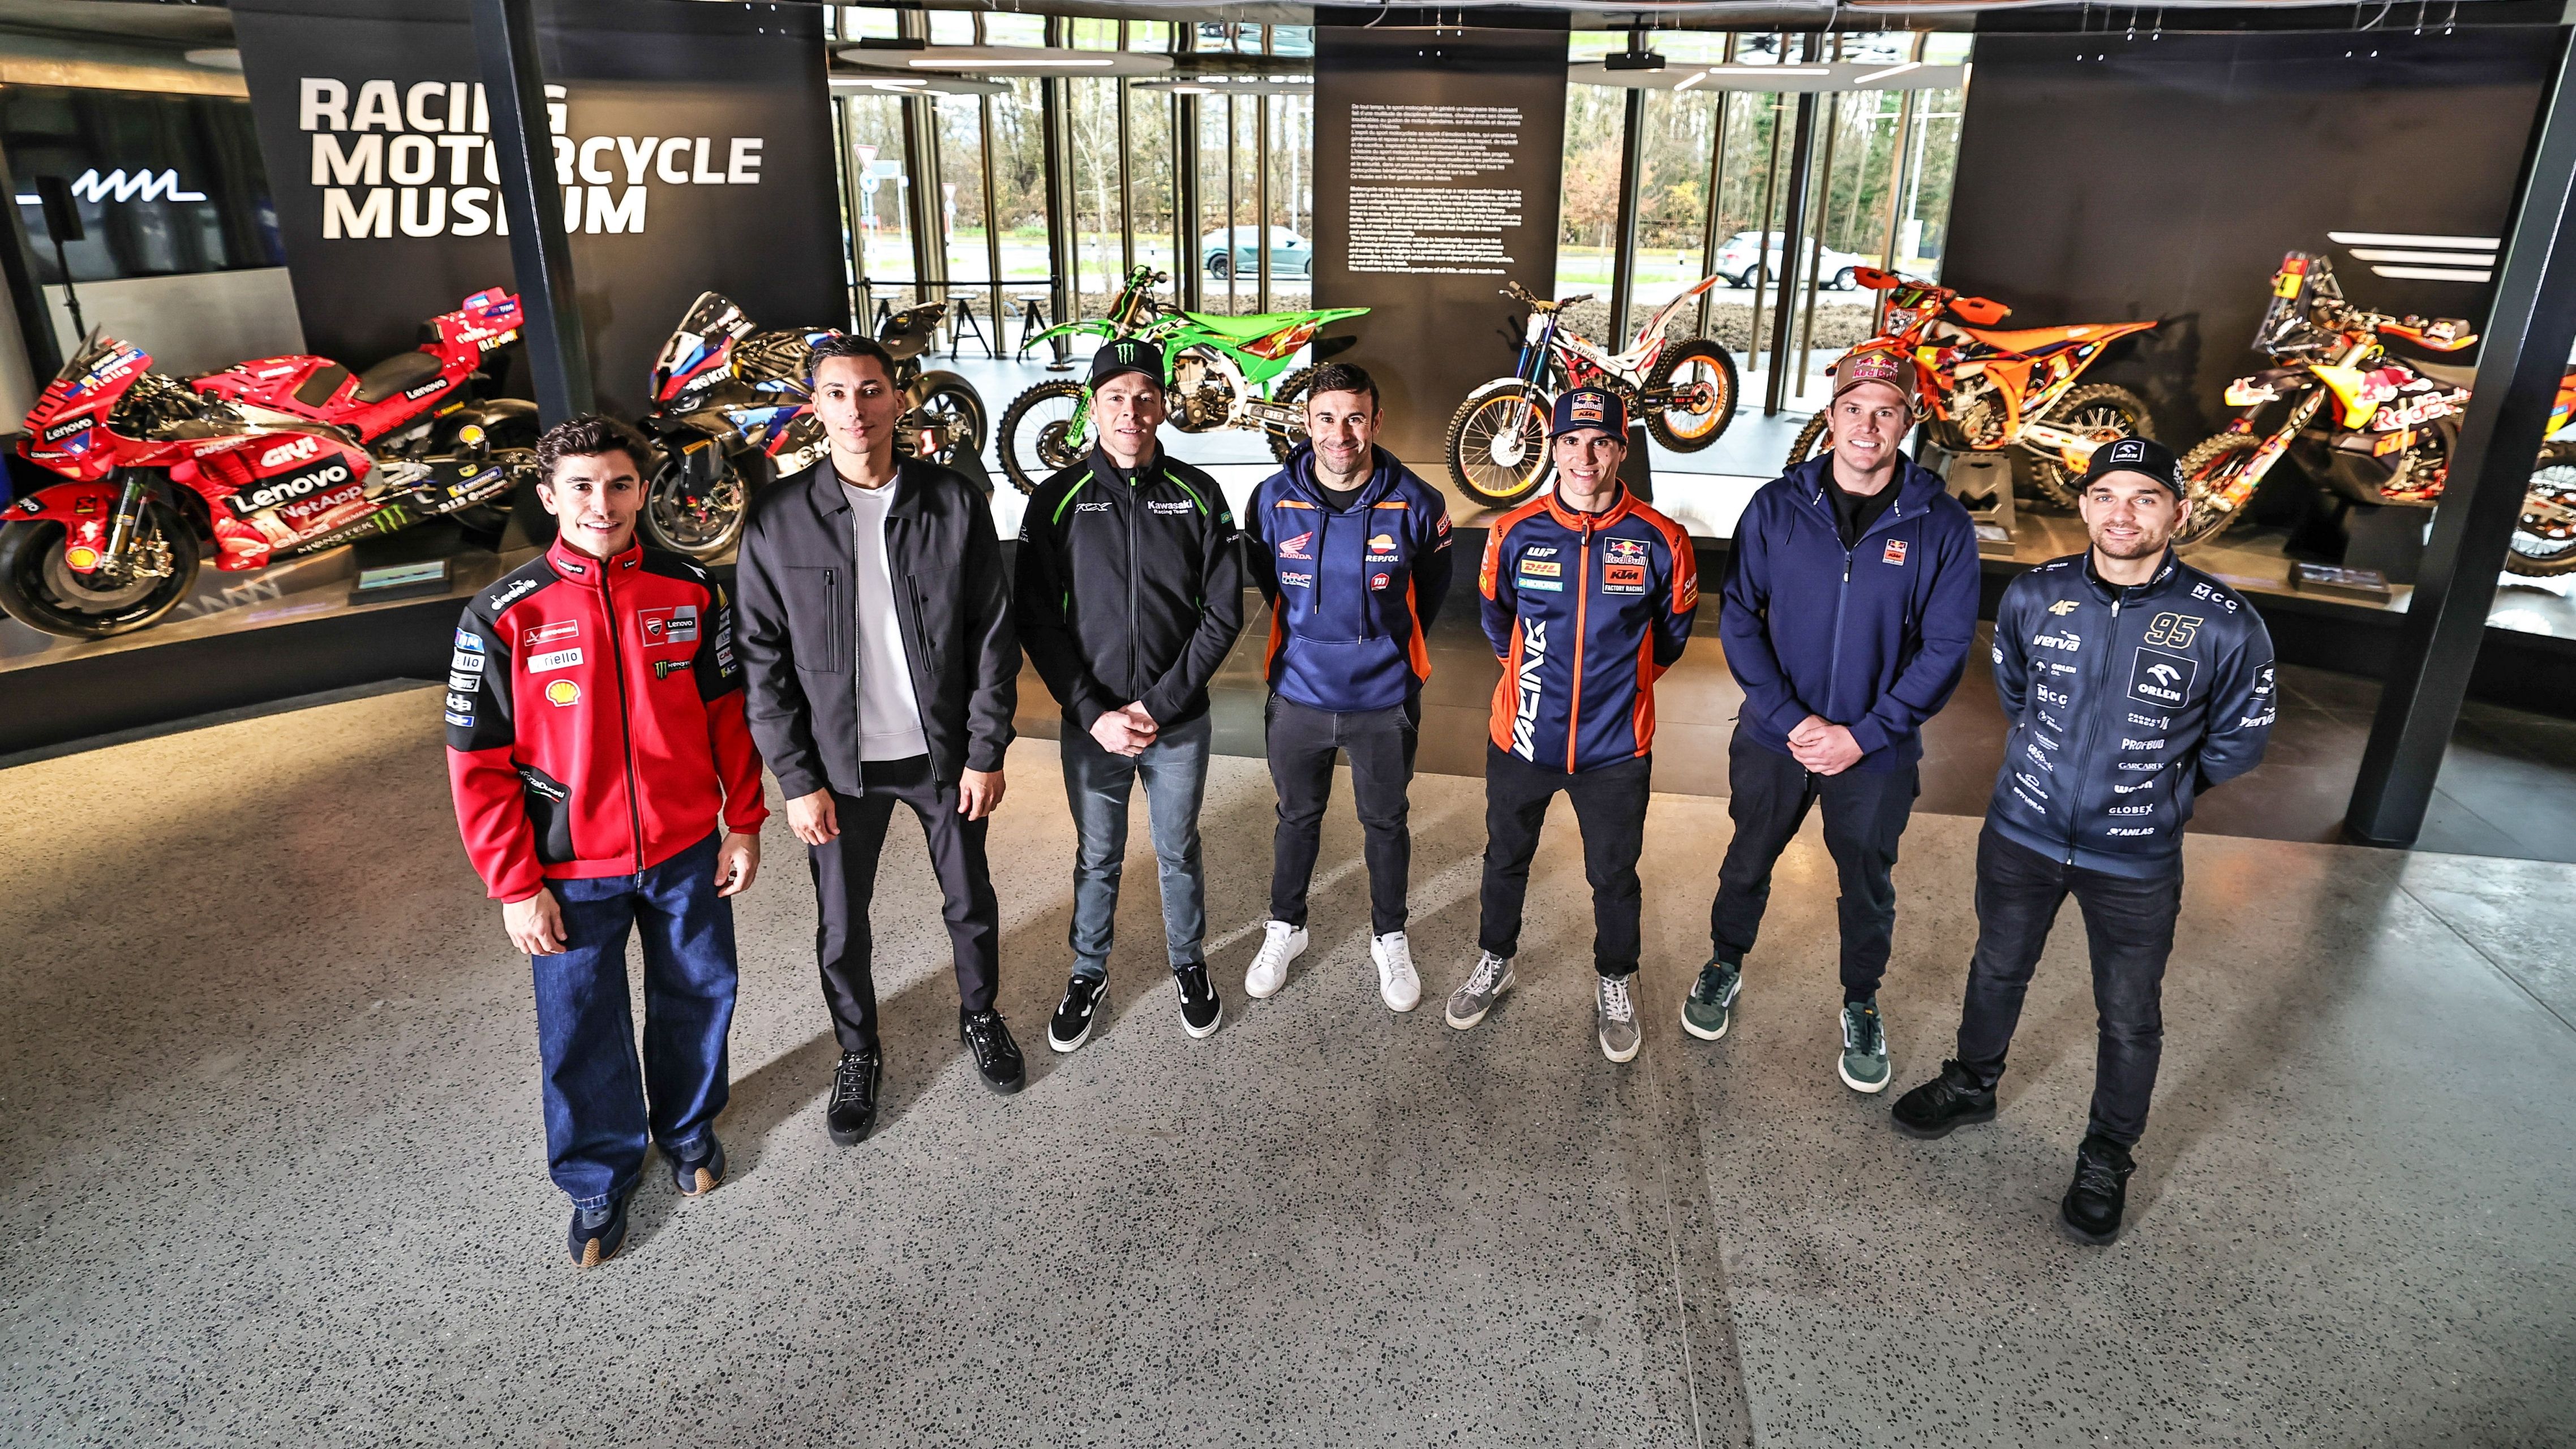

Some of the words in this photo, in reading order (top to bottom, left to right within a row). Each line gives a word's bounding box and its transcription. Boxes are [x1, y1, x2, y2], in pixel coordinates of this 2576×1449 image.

[299, 77, 568, 134] RACIG
[312, 133, 764, 186] MOTRCYCLE
[323, 185, 647, 240] MUSM
[1571, 343, 1599, 360] REPSOL
[1853, 368, 1875, 380] Red
[1875, 369, 1897, 382] Bull
[406, 379, 448, 399] Lenovo
[1573, 401, 1589, 410] Red
[1588, 403, 1603, 411] Bull
[45, 418, 93, 440] Lenovo
[920, 429, 938, 455] 1
[233, 466, 348, 513] Lenovo
[281, 485, 364, 517] NetApp
[1148, 499, 1193, 509] Kawasaki
[1526, 547, 1558, 557] WP
[1605, 552, 1626, 564] Red
[1625, 554, 1647, 566] Bull
[1524, 562, 1557, 574] DHL
[1609, 569, 1639, 581] KTM
[1282, 571, 1312, 583] HRC
[491, 579, 538, 610] diadora
[2048, 600, 2080, 616] 4F
[667, 620, 693, 629] Lenovo
[2143, 612, 2205, 650] 95
[2033, 634, 2081, 652] verva
[544, 652, 578, 666] riello
[2051, 663, 2077, 674] ORLEN
[2037, 683, 2068, 705] MCG
[2137, 683, 2181, 702] ORLEN
[2127, 717, 2156, 727] CARGO
[2128, 712, 2161, 724] PROMET
[2121, 738, 2165, 750] PROFBUD
[2109, 803, 2153, 815] GLOBEX
[2119, 827, 2154, 836] ANLAS
